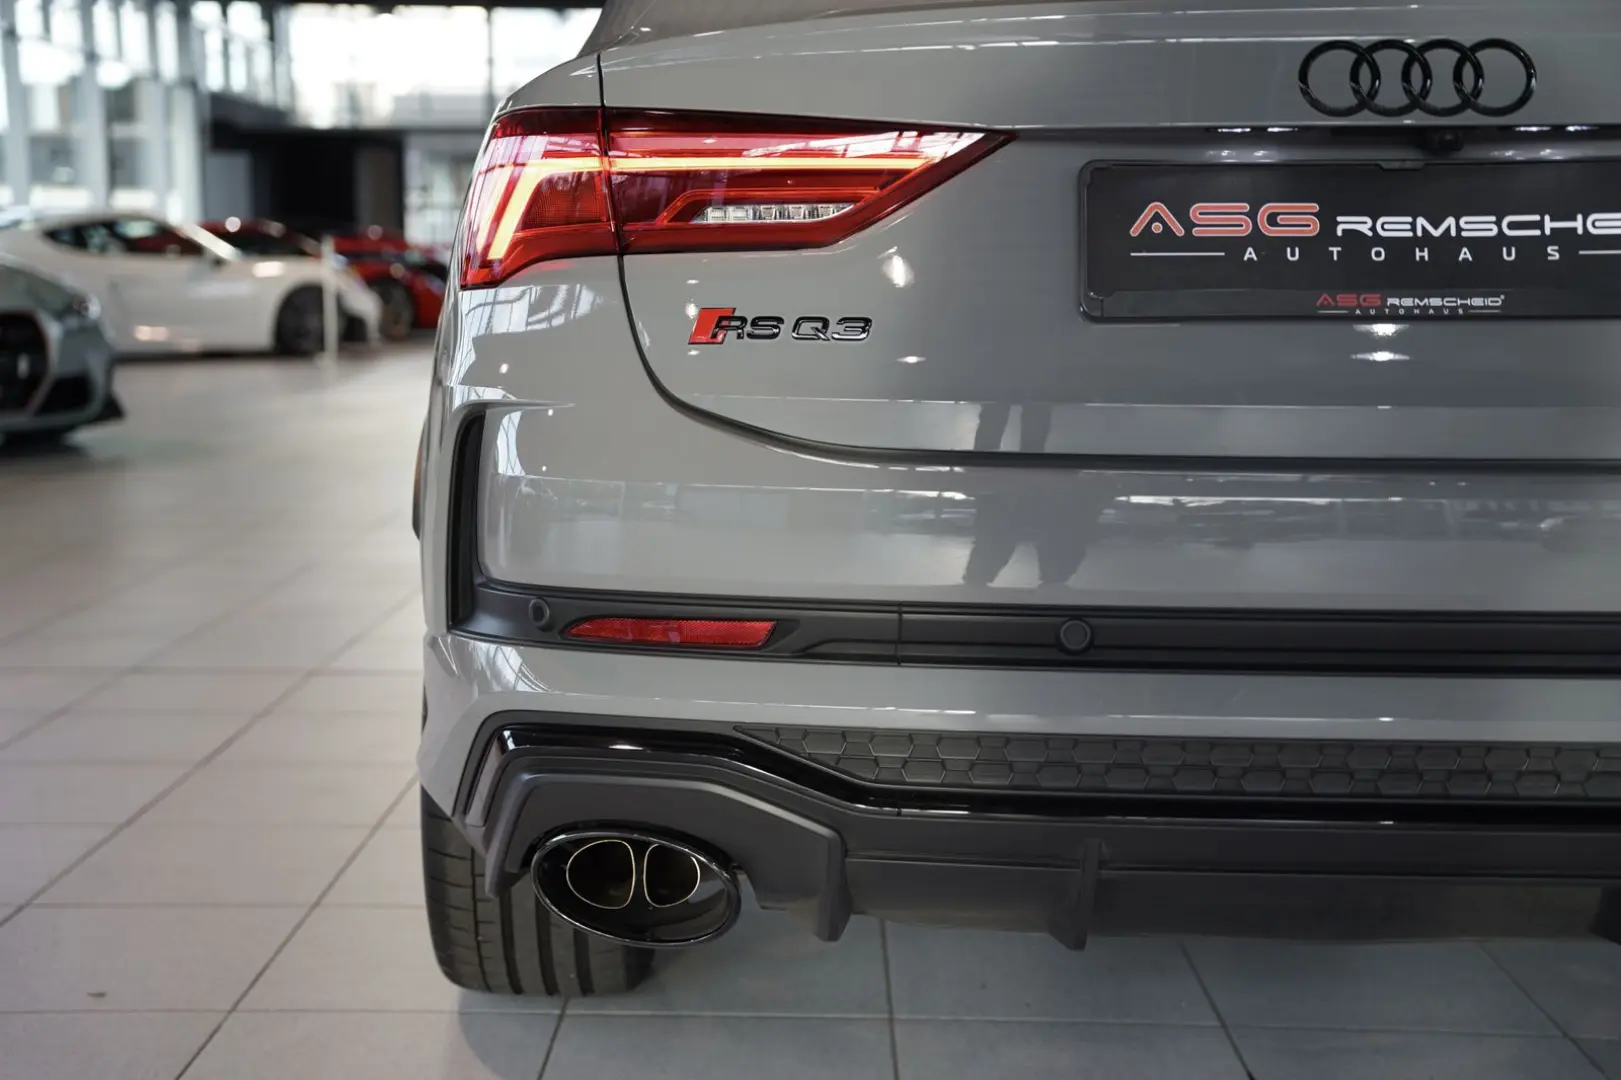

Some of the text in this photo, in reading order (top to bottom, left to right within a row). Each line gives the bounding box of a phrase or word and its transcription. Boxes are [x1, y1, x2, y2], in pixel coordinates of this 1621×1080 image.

[1129, 201, 1320, 237] ASG
[1243, 246, 1561, 262] AUTOHAUS
[1316, 293, 1381, 307] ASG
[708, 314, 873, 342] RS Q3
